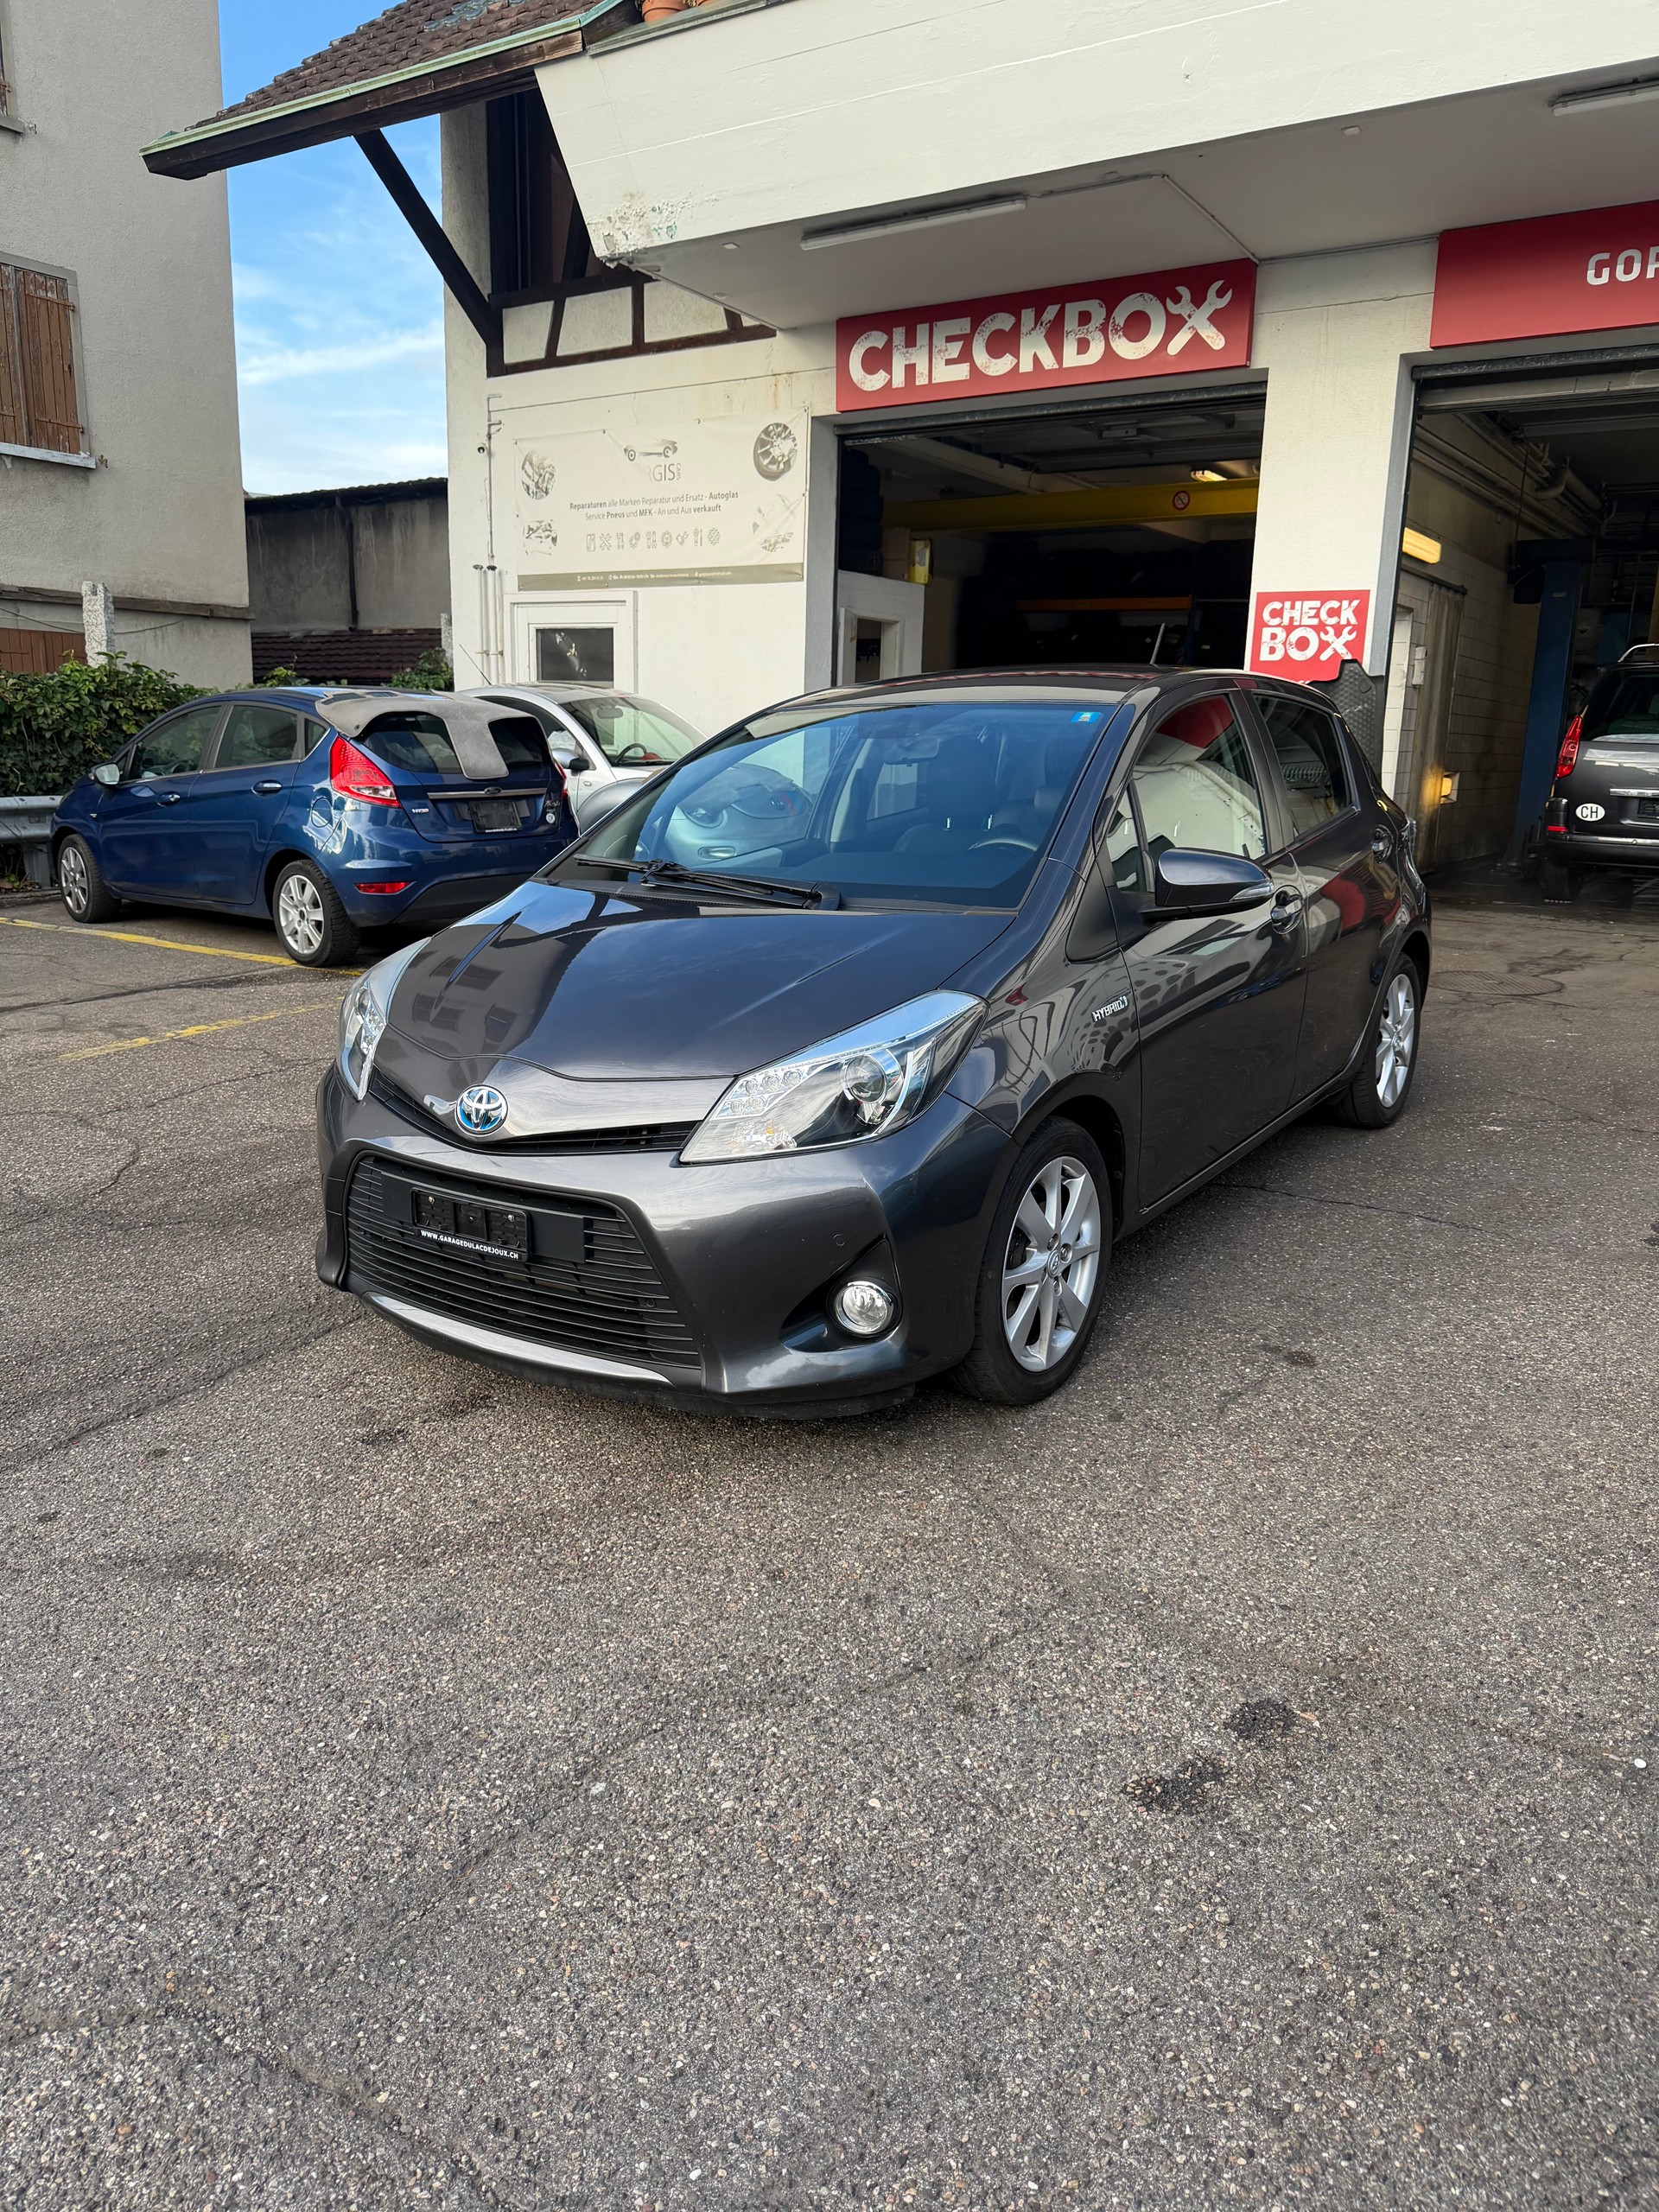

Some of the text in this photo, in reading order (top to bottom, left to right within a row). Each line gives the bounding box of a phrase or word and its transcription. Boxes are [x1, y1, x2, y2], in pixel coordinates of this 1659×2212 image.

[849, 280, 1233, 391] CHECKBOX
[569, 501, 607, 511] Reparaturen
[619, 498, 641, 506] Marken
[641, 496, 671, 506] Reparatur
[671, 494, 684, 503] und
[685, 493, 704, 502] Ersatz
[709, 491, 739, 500] Autoglas
[693, 504, 721, 513] verkauft
[1262, 600, 1361, 626] CHECK
[1259, 626, 1357, 661] BOX
[1580, 805, 1599, 818] CH
[1091, 999, 1122, 1021] HYBRID
[420, 1230, 518, 1259] WWW.GARAGEDULACDEJOUX.CH
